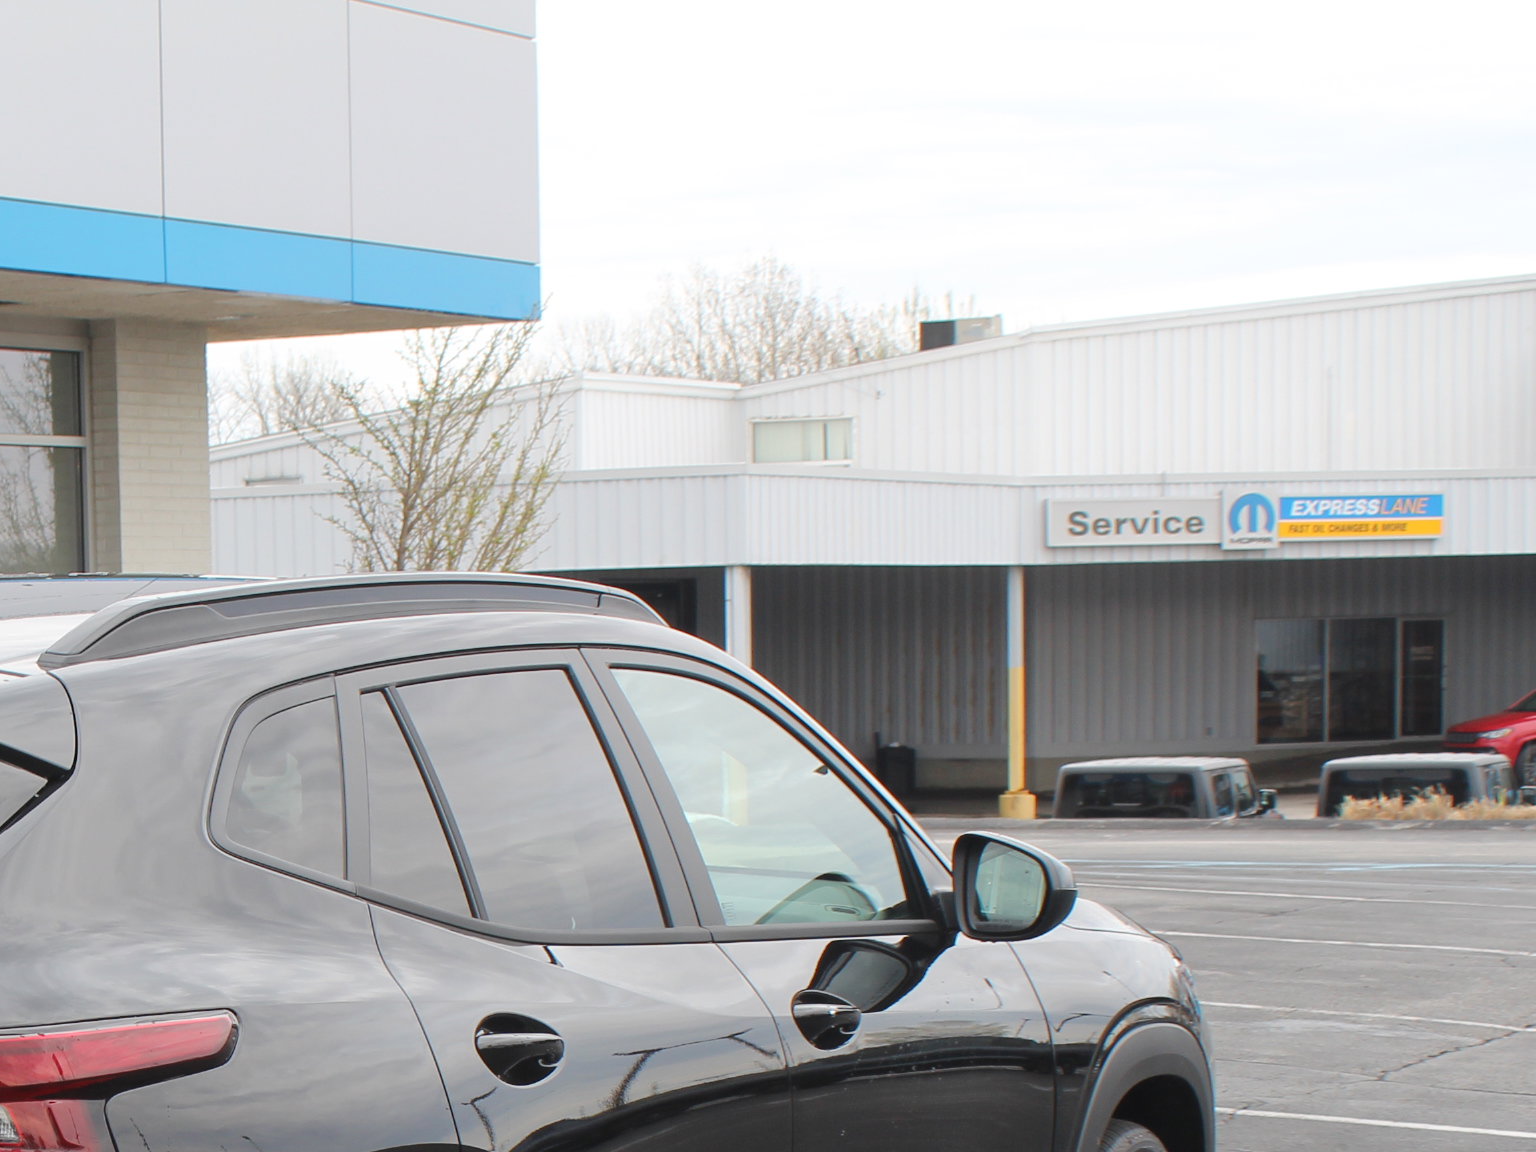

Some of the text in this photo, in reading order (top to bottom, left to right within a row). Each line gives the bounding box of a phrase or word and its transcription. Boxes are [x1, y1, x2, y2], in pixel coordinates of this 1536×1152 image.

[1067, 509, 1205, 536] Service
[1288, 523, 1408, 534] FAST OIL CHANGES & MORE
